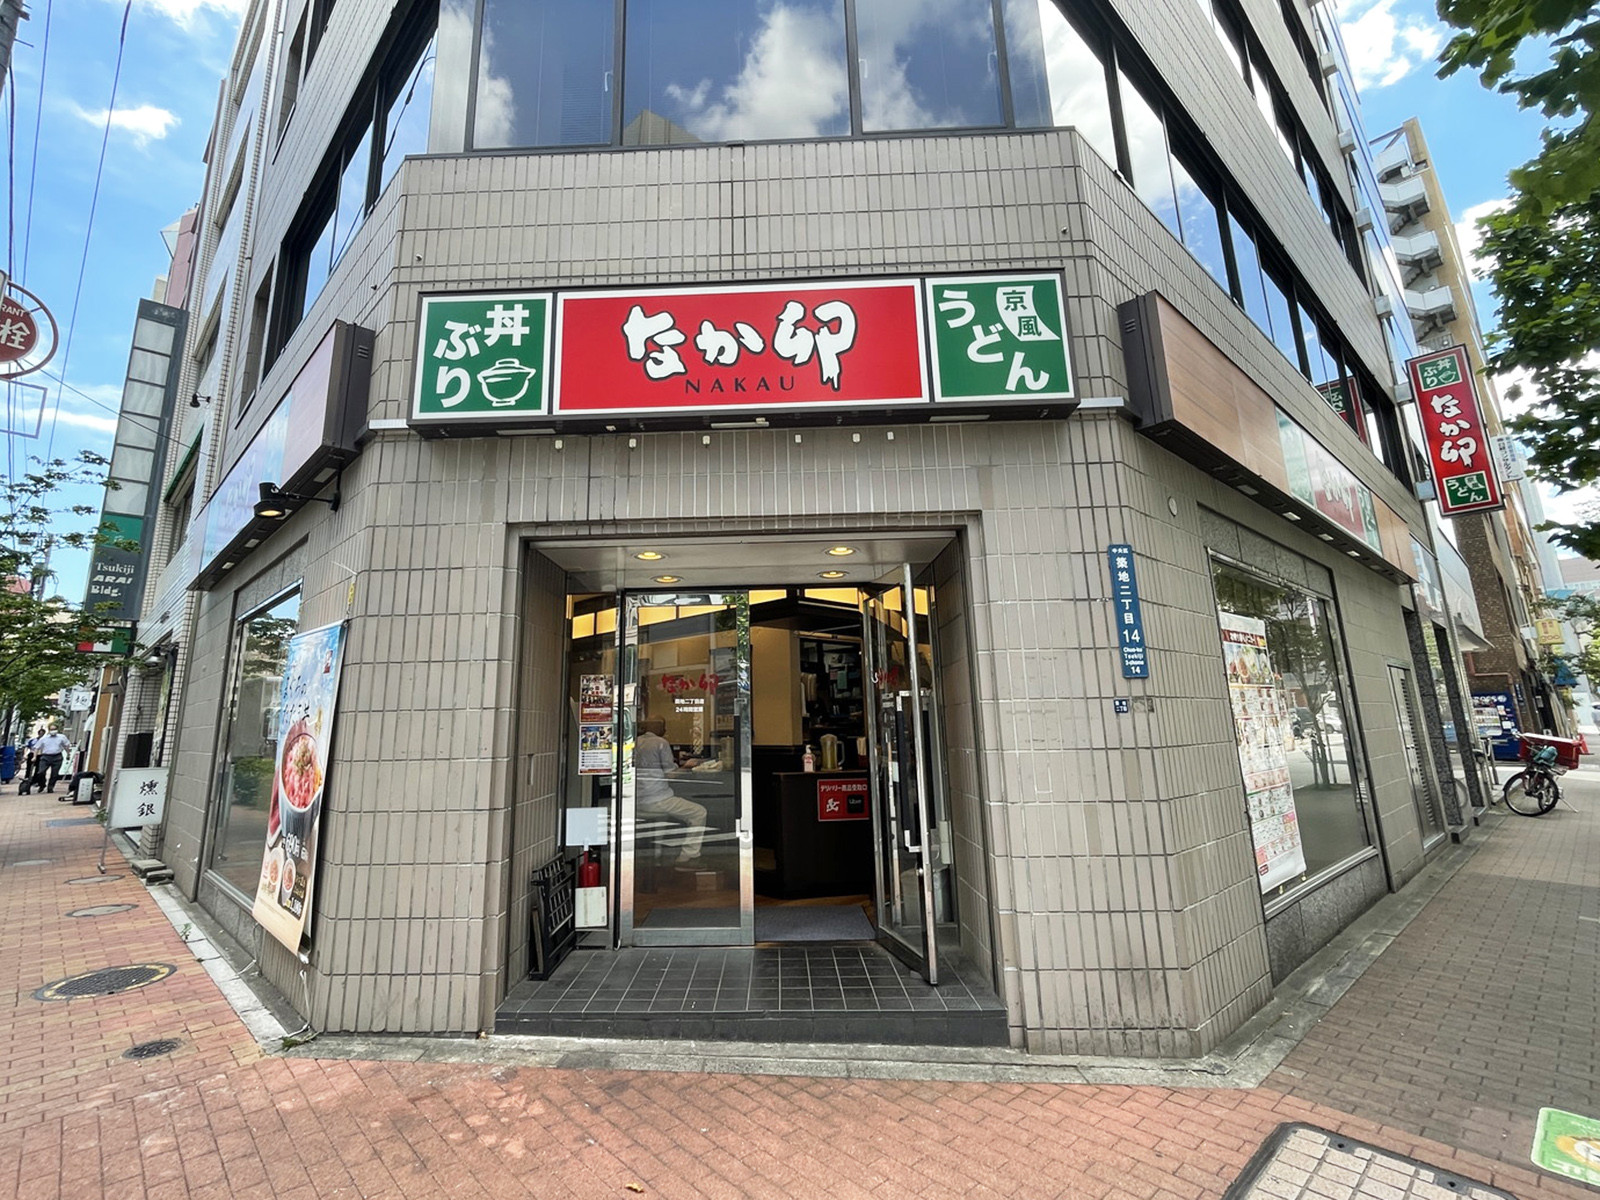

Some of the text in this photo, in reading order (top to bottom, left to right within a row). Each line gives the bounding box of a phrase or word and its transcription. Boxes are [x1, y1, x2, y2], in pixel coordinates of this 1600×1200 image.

[1002, 289, 1042, 337] 京風
[622, 300, 857, 391] なか卯
[938, 289, 1050, 392] うどん
[685, 376, 795, 394] NAKAU
[1430, 394, 1477, 468] なか卯
[1447, 479, 1484, 503] うどん
[96, 562, 135, 576] Tsukiji
[93, 575, 133, 585] ARAI
[1115, 556, 1135, 625] 築地二丁目
[91, 585, 121, 597] Bldg.
[1122, 628, 1141, 643] 14
[1131, 666, 1141, 674] 14
